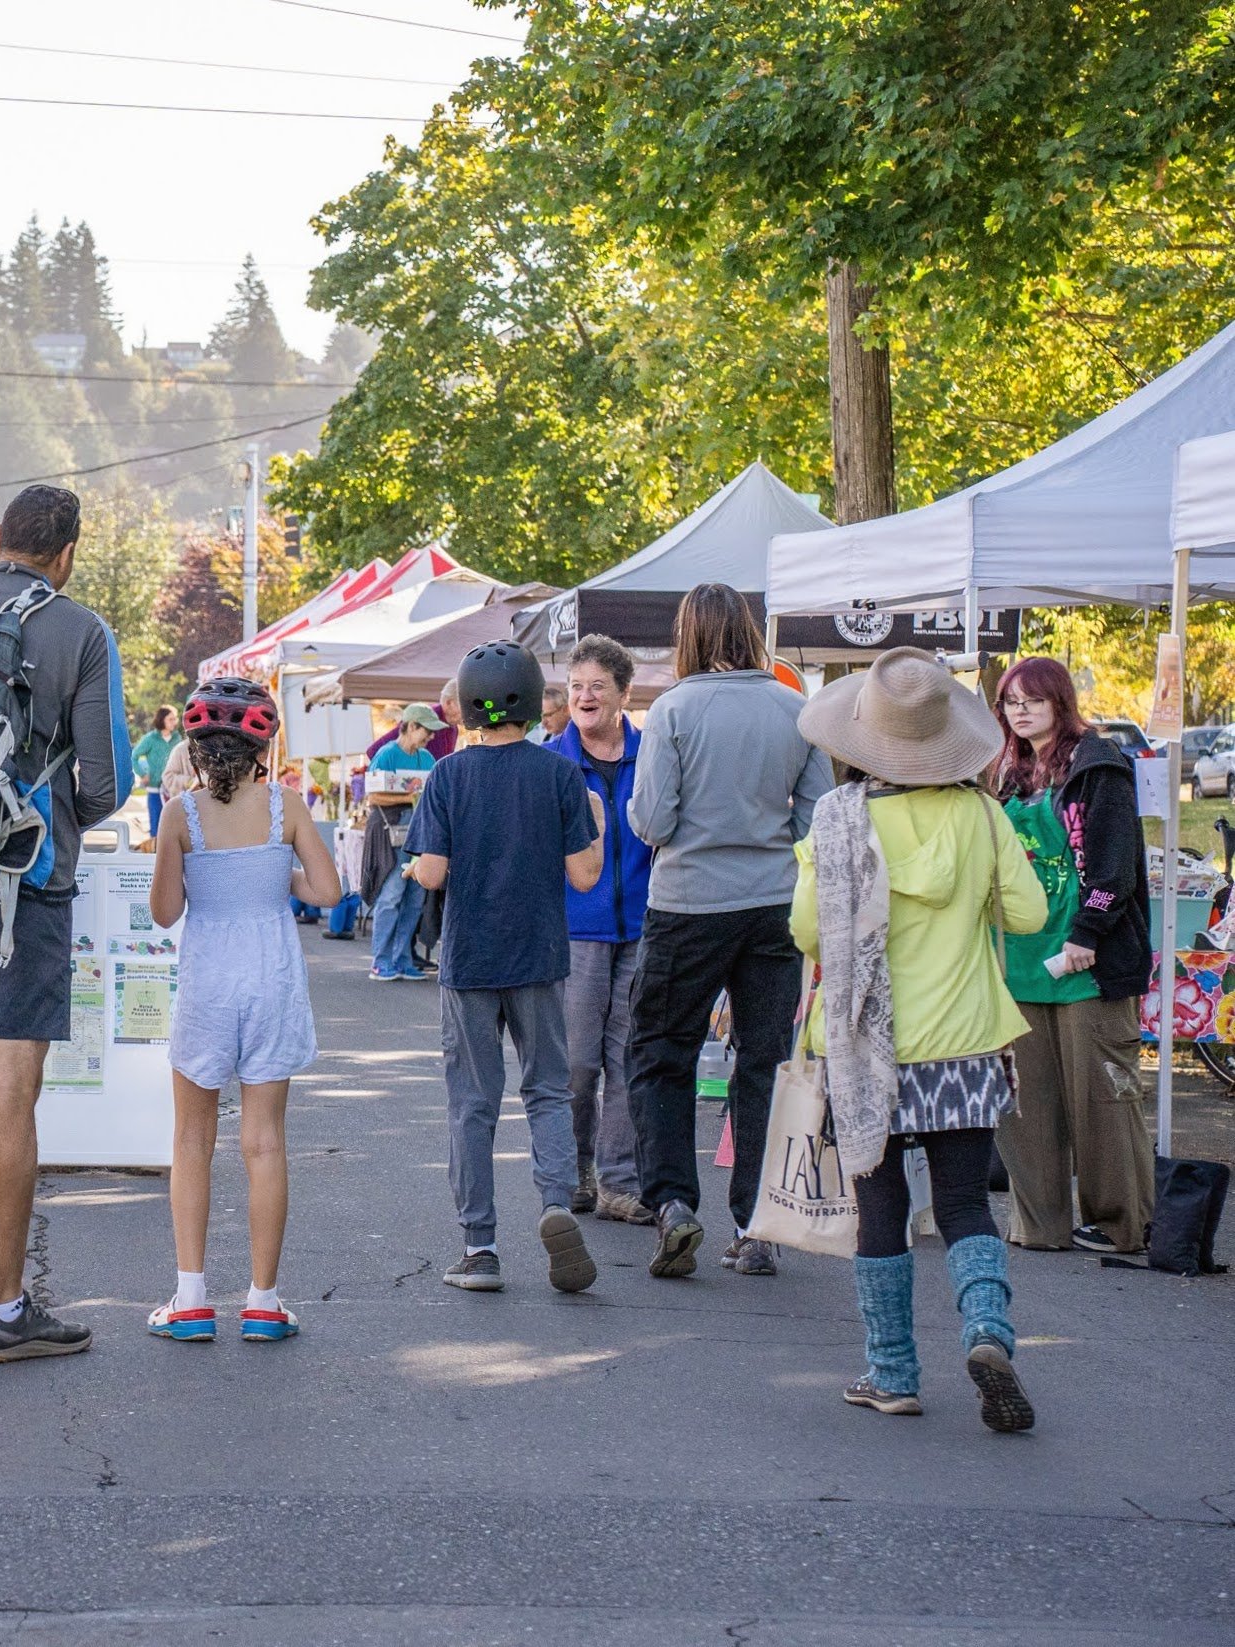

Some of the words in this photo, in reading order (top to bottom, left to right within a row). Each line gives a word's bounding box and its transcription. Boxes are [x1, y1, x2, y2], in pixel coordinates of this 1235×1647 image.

[1091, 889, 1116, 900] HELLO
[1085, 897, 1111, 910] KITTY
[769, 1192, 796, 1211] YOGA
[798, 1206, 859, 1218] THERAPIS
